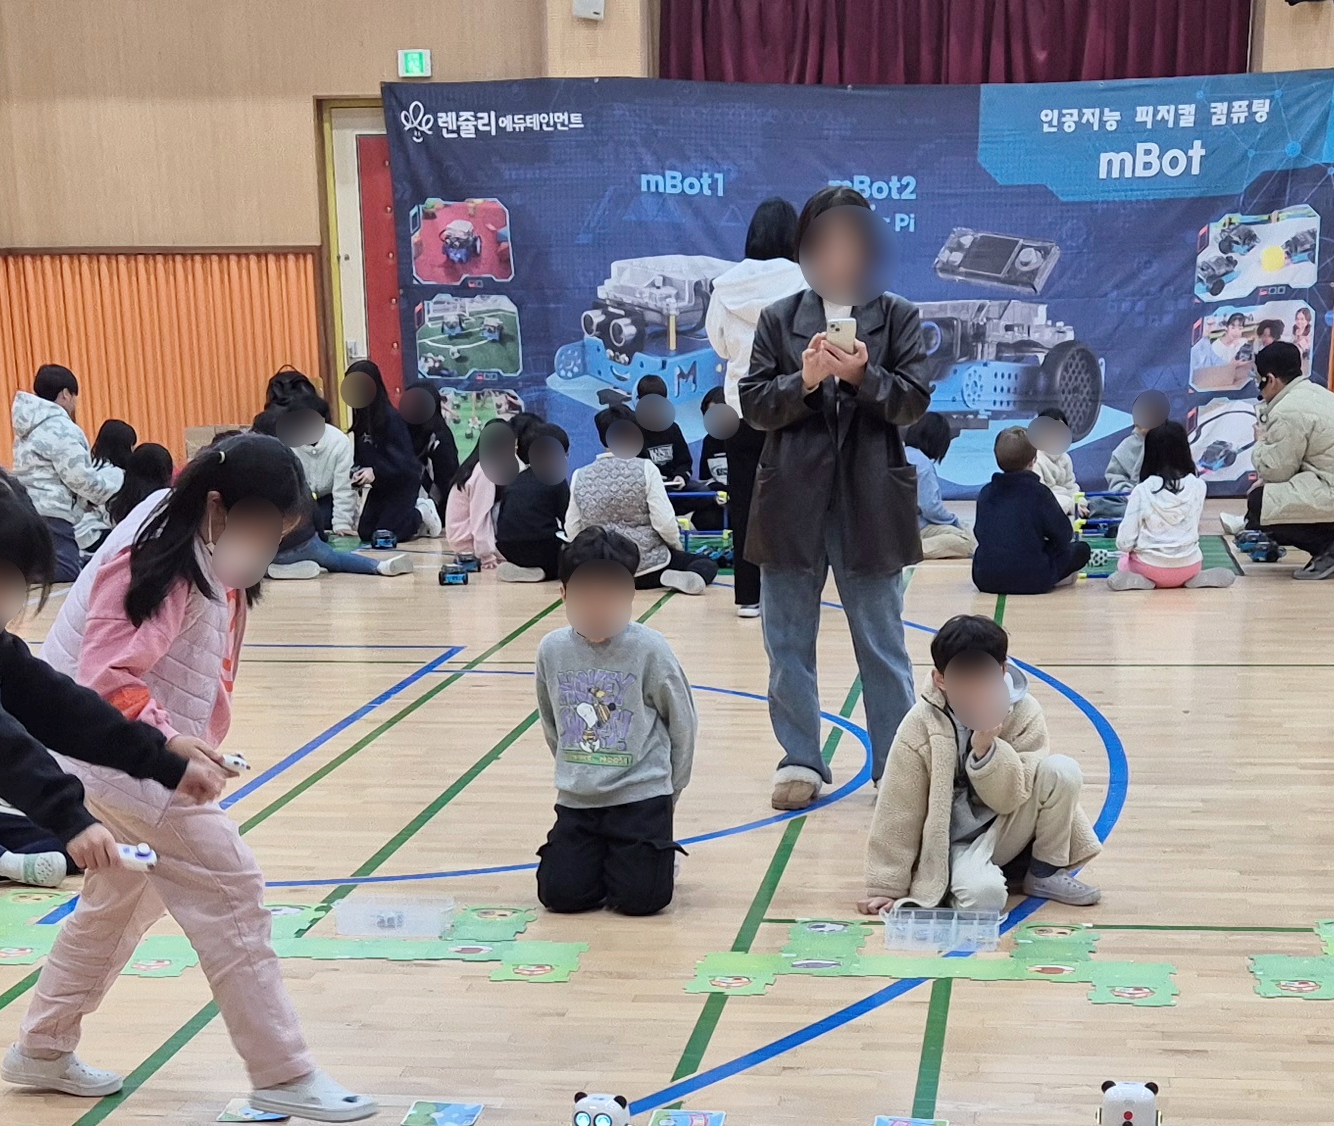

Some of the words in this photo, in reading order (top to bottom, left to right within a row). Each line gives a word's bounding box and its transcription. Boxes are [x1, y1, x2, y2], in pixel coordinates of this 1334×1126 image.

[436, 110, 497, 139] 렌쥴리
[497, 111, 585, 133] 에듀테인먼트
[1039, 107, 1122, 133] 인공지능
[1134, 103, 1197, 129] 피지컬
[1209, 98, 1271, 127] 컴퓨팅
[1098, 139, 1206, 179] mBot
[640, 170, 725, 197] mBot1
